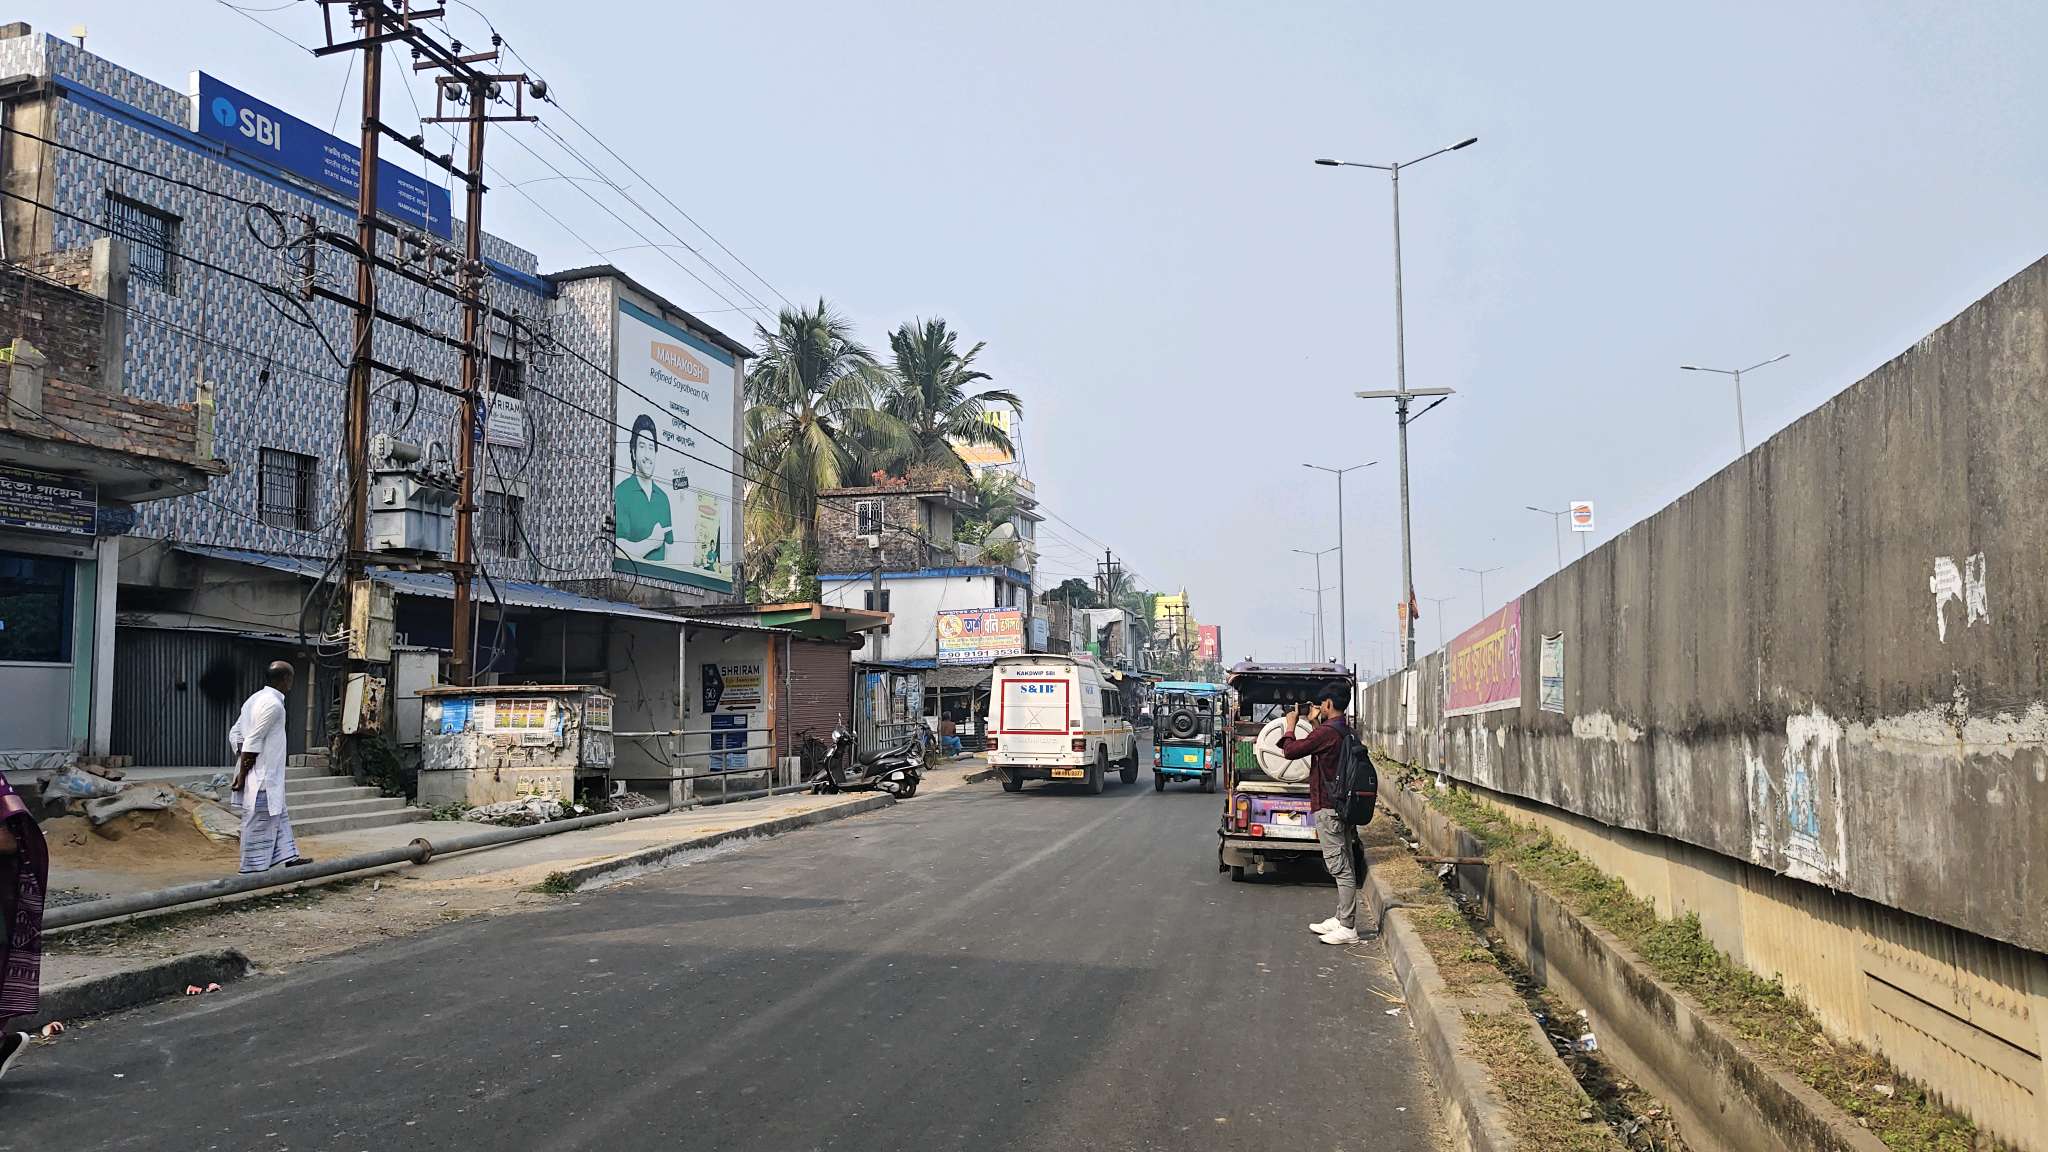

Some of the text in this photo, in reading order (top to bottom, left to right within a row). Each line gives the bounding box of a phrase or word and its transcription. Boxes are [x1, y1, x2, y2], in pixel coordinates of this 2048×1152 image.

[239, 108, 281, 151] SBI
[324, 169, 340, 180] STATE
[340, 175, 353, 186] BANK
[656, 346, 704, 379] MAHAKOSH
[651, 368, 672, 382] Refined
[673, 378, 700, 397] Soyabean
[0, 478, 82, 499] দিত্য গায়েন
[395, 631, 409, 646] BI
[964, 650, 989, 658] 9191
[994, 648, 1020, 656] 3536
[722, 665, 760, 676] SHRIRAM
[1020, 684, 1055, 695] S&IB
